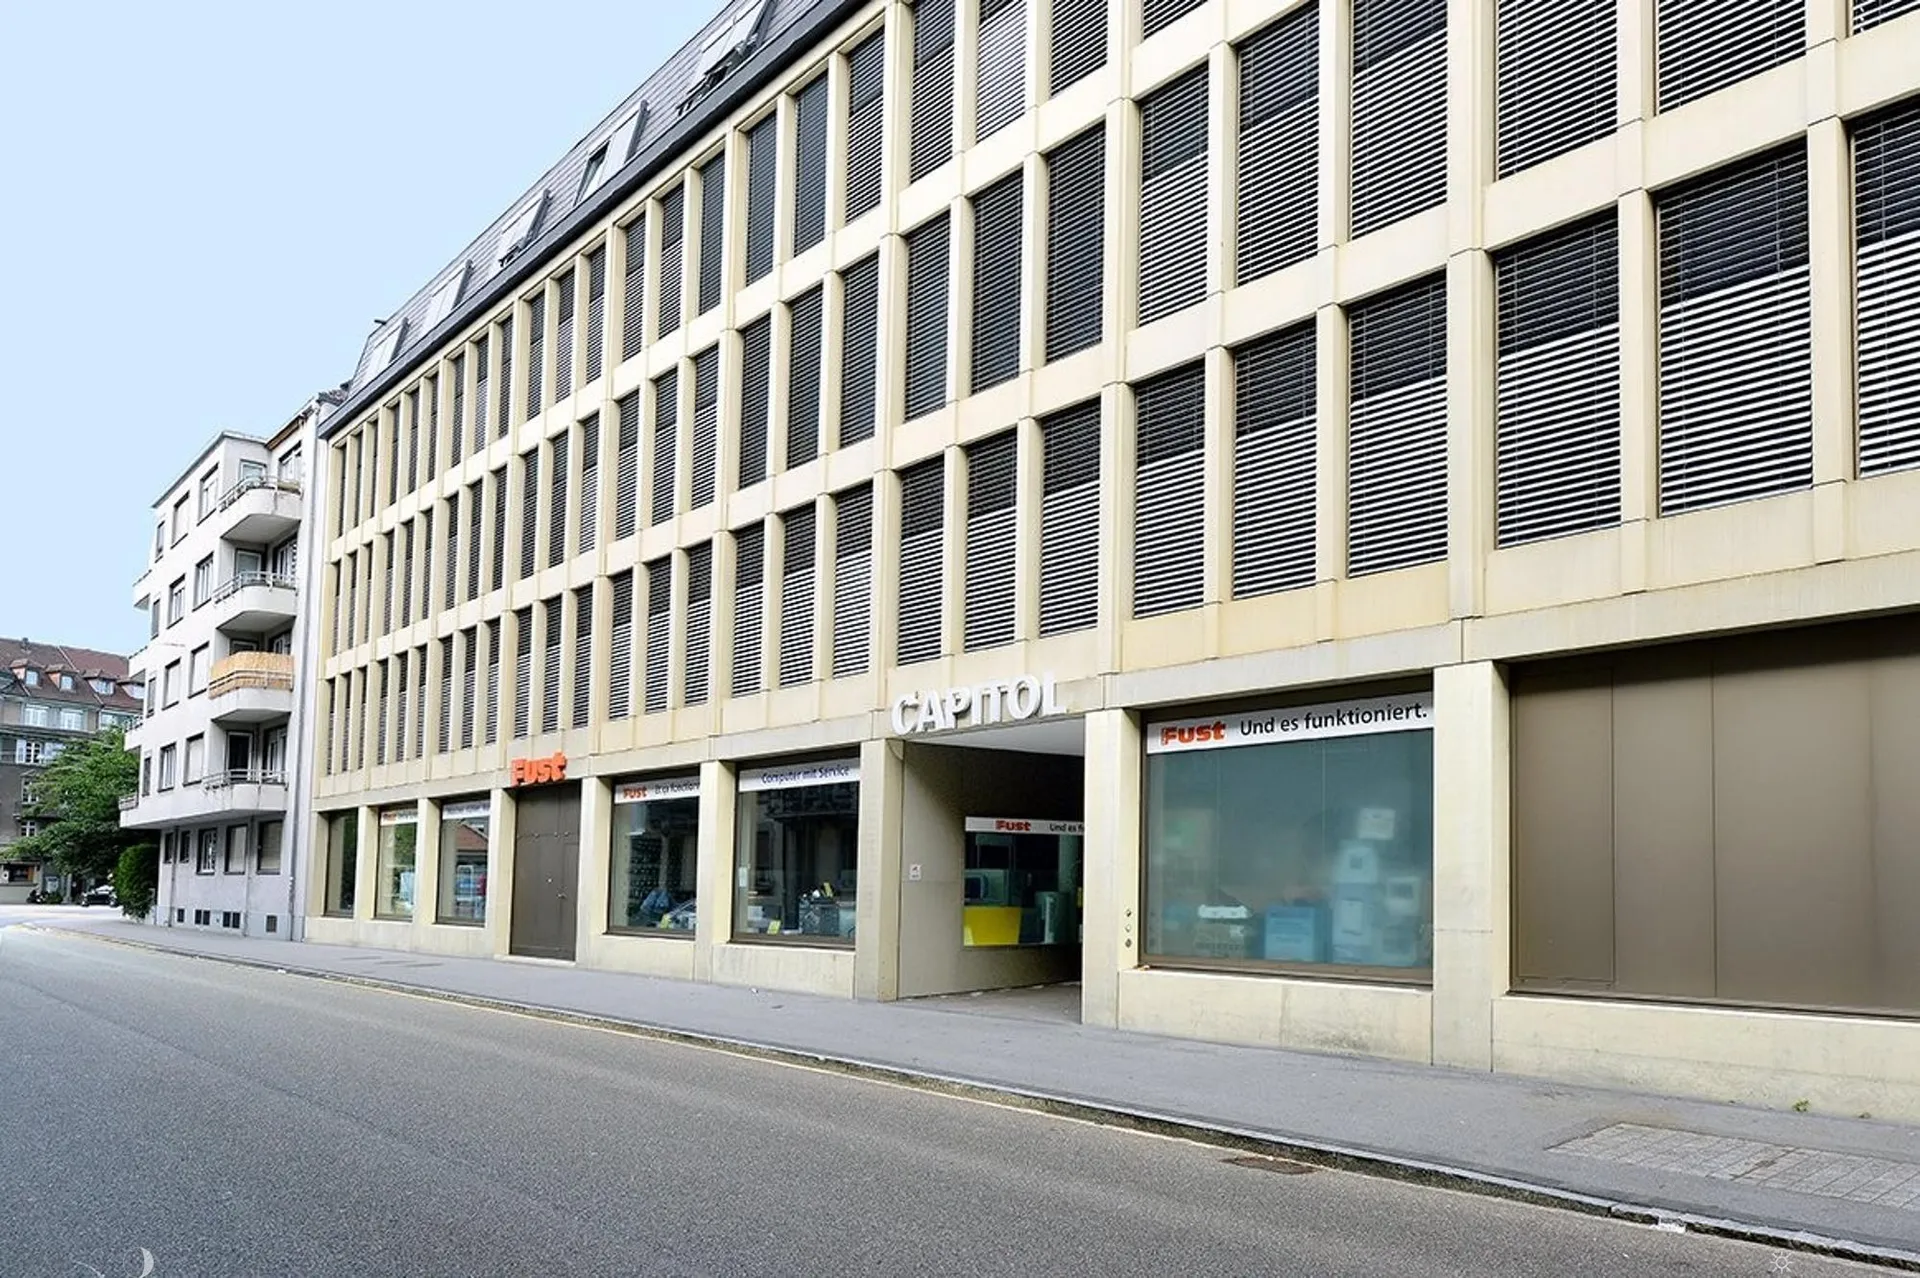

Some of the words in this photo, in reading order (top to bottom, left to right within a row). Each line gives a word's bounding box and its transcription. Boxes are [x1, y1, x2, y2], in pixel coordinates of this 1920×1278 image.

[891, 671, 1068, 735] CAPITOL
[1161, 720, 1227, 745] Fust
[1240, 717, 1275, 736] Und
[1280, 720, 1299, 731] es
[1305, 702, 1427, 729] funktioniert.
[511, 750, 568, 787] Fust
[818, 764, 850, 778] Service
[995, 820, 1031, 832] Fust
[1048, 822, 1065, 831] Und
